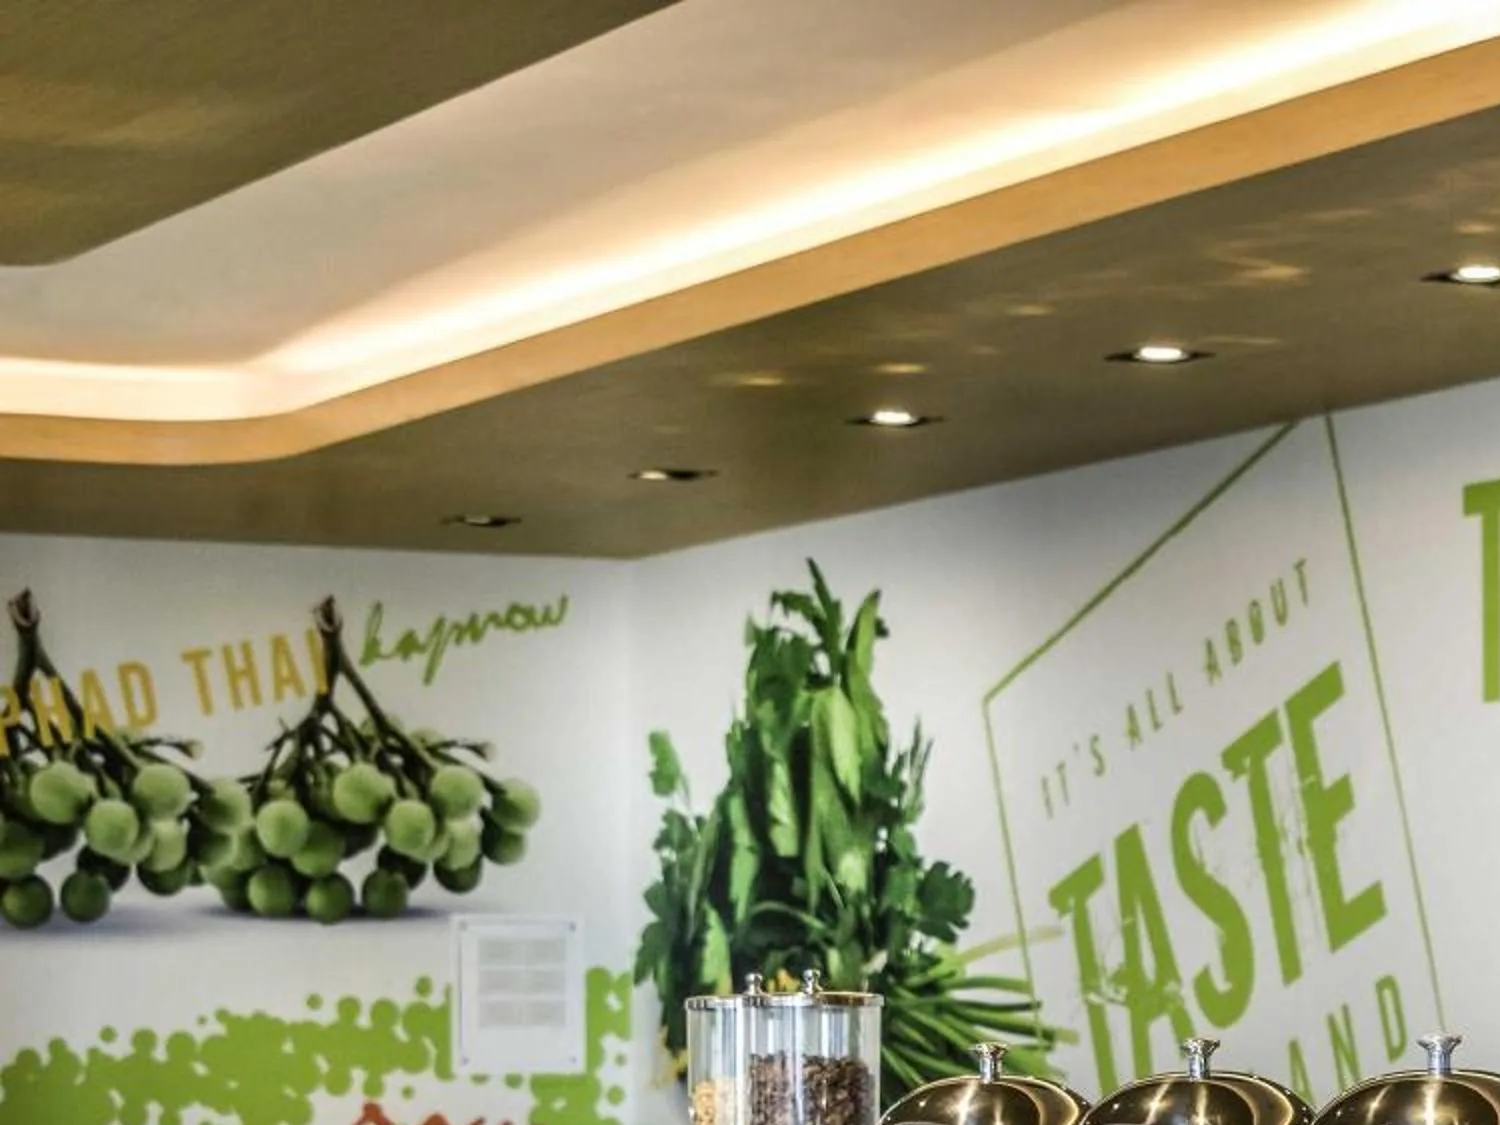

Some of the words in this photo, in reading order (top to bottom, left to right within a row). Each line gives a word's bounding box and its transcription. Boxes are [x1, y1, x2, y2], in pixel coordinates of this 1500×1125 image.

[181, 627, 329, 716] THAI
[1125, 671, 1184, 751] ALL
[1203, 557, 1309, 686] ABOUT
[1047, 660, 1388, 1097] TASTE
